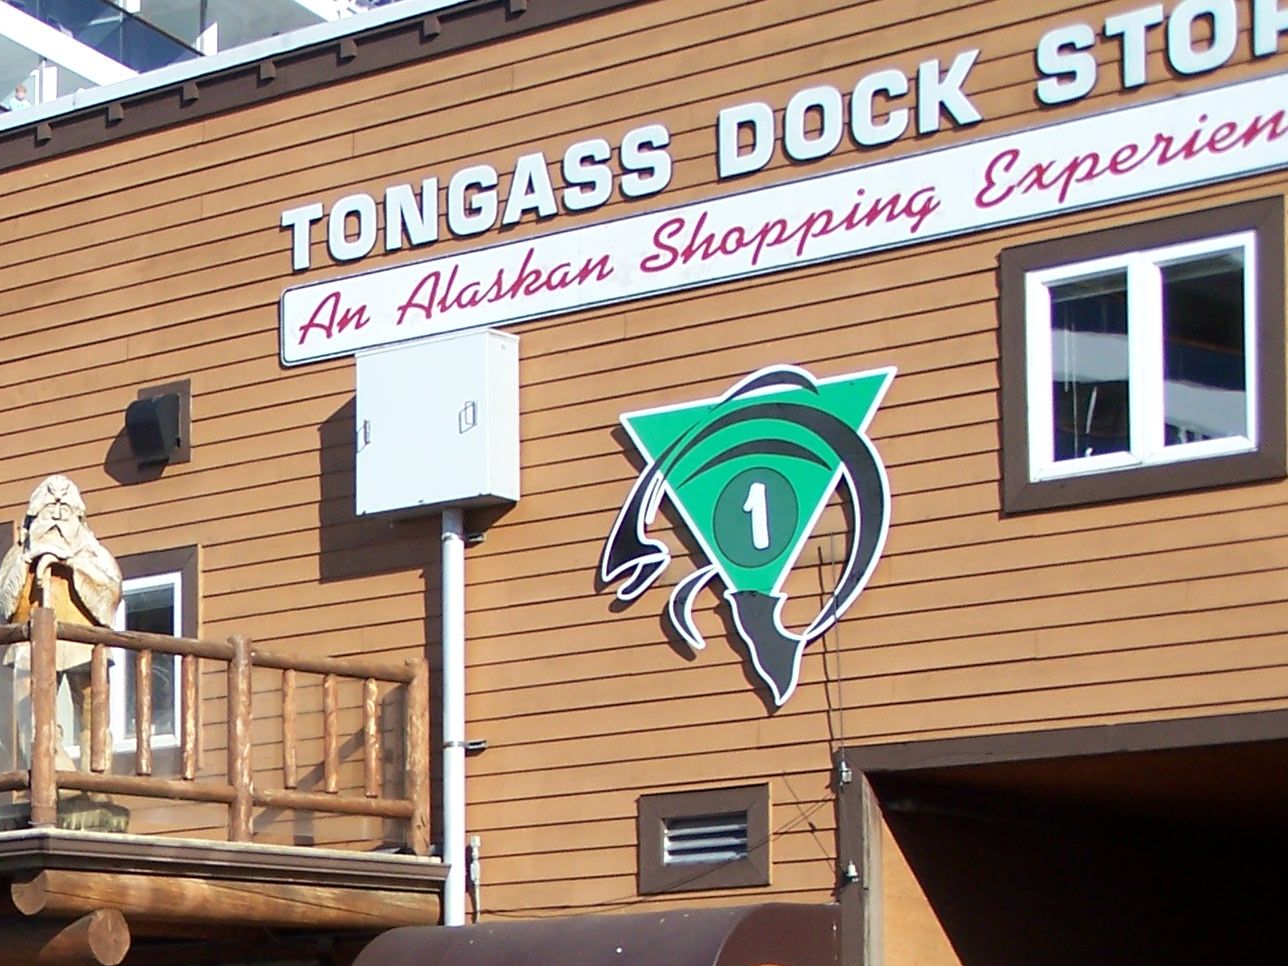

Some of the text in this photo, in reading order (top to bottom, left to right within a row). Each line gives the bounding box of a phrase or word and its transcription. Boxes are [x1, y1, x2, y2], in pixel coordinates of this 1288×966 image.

[281, 124, 673, 271] TONGASS
[717, 49, 983, 179] DOCK
[298, 291, 371, 345] An
[396, 247, 614, 325] Alaskan
[639, 186, 941, 274] Shopping
[743, 482, 770, 550] 1
